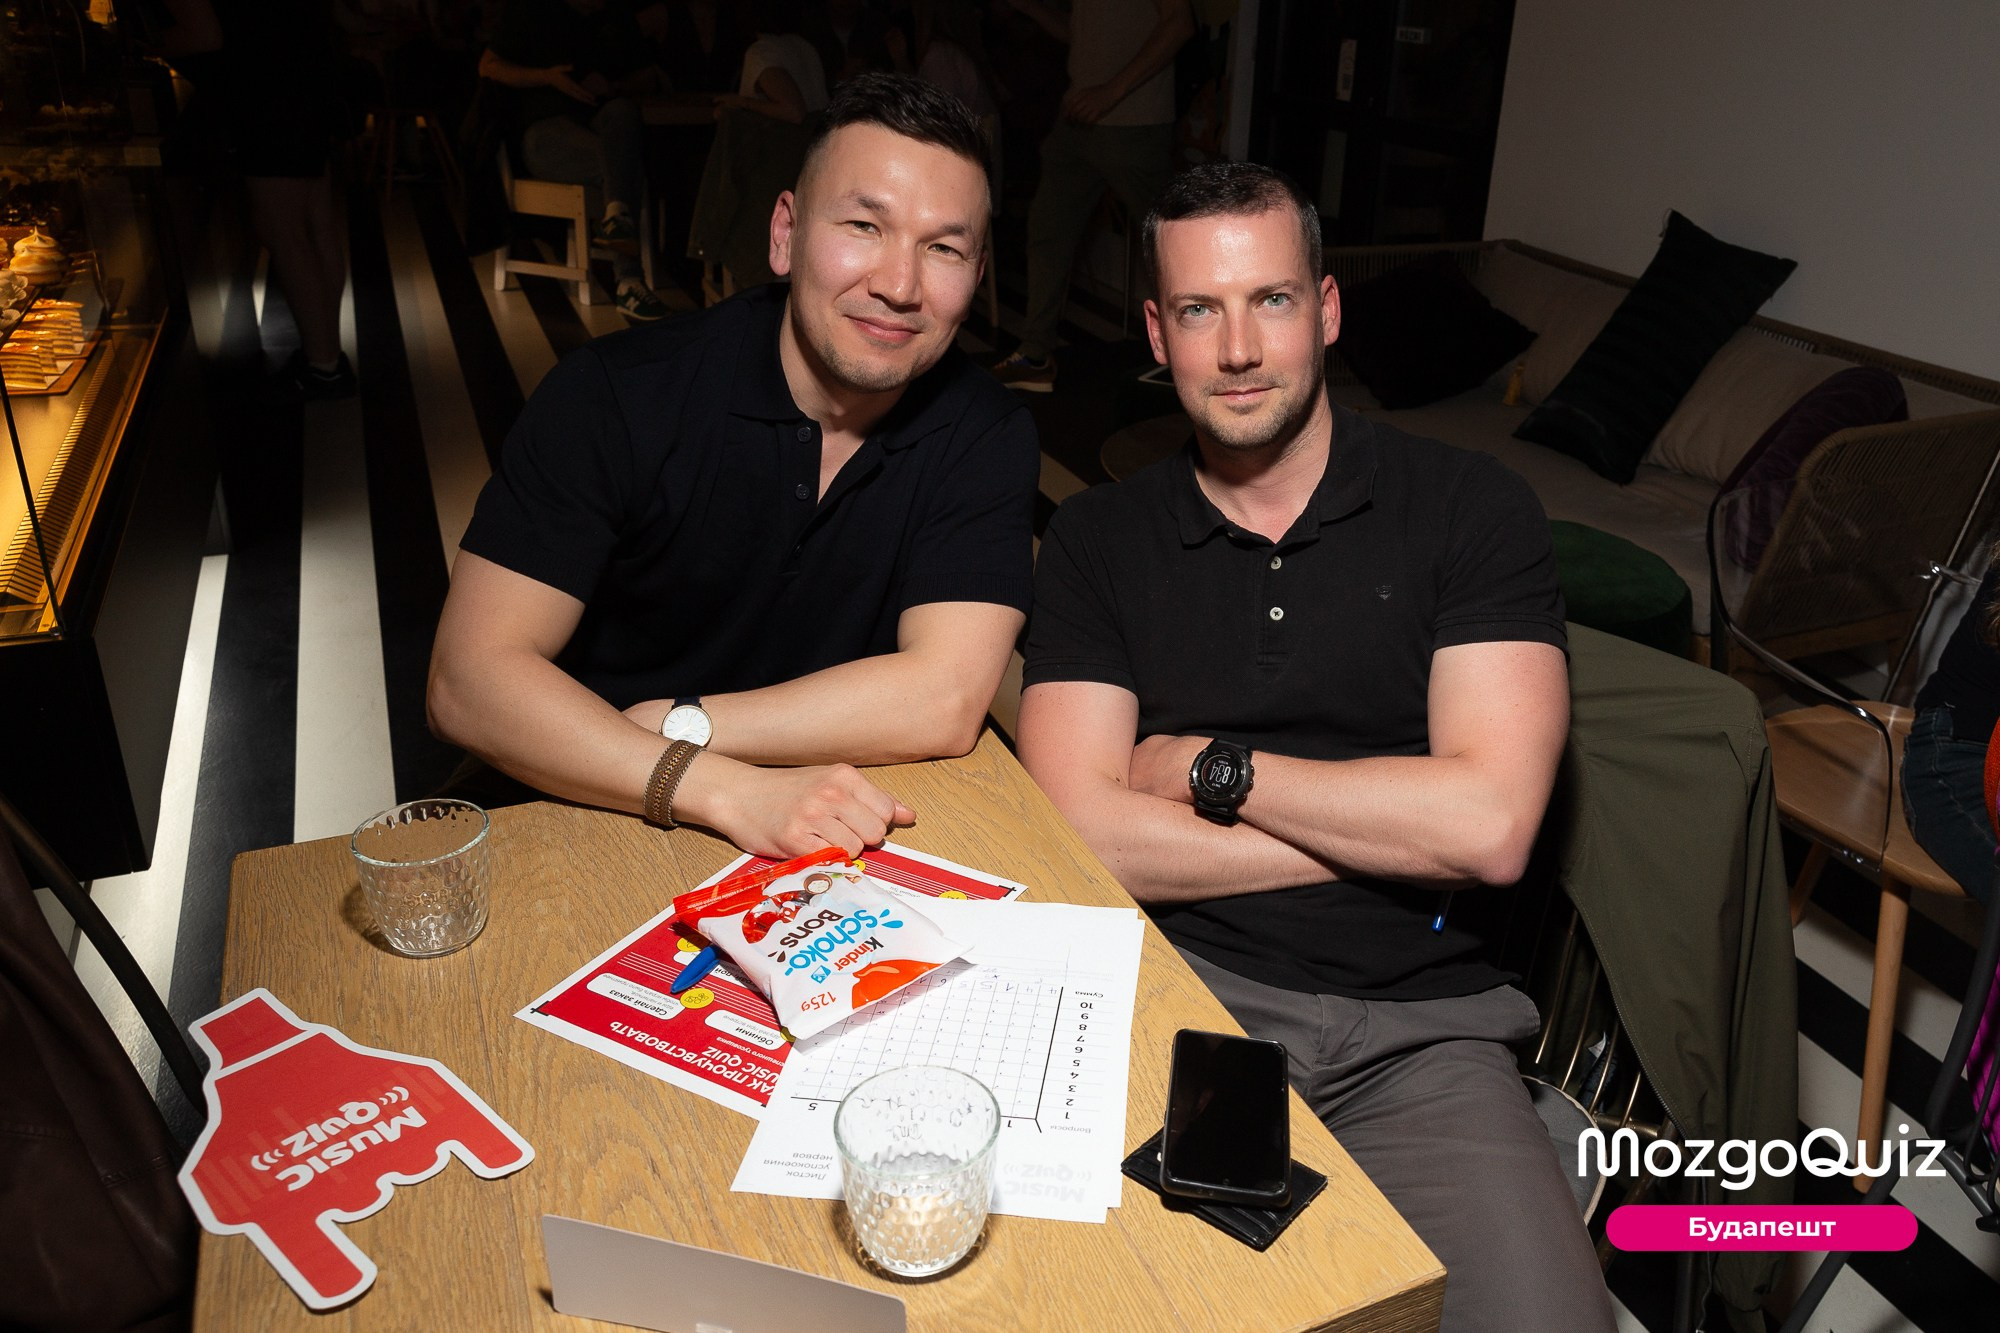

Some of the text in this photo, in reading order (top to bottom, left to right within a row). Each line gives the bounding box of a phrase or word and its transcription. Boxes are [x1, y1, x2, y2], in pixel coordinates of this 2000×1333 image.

[779, 908, 844, 950] Bons
[784, 908, 878, 977] Schoko-
[1074, 990, 1104, 999] Сумма
[609, 989, 668, 1016] Сделай заказ
[800, 990, 837, 1013] 125g
[1079, 1001, 1094, 1010] 10
[1080, 1012, 1089, 1021] 9
[1078, 1023, 1088, 1032] 8
[735, 1026, 774, 1047] Обними
[1076, 1034, 1085, 1043] 7
[610, 1020, 748, 1085] ПРОЧУВСТВОВАТЬ
[1074, 1046, 1084, 1054] 6
[751, 1049, 785, 1067] спешного
[1072, 1059, 1081, 1067] 5
[701, 1045, 780, 1085] USIC QUIZ
[1070, 1071, 1079, 1080] 4
[1067, 1084, 1077, 1093] 3
[808, 1102, 818, 1112] 5
[1065, 1098, 1075, 1106] 2
[1064, 1111, 1071, 1120] 1
[1006, 1118, 1014, 1128] 1
[1049, 1124, 1092, 1135] Вопросы
[792, 1152, 833, 1161] нервов
[763, 1159, 831, 1170] успокоения
[786, 1170, 826, 1181] Листок
